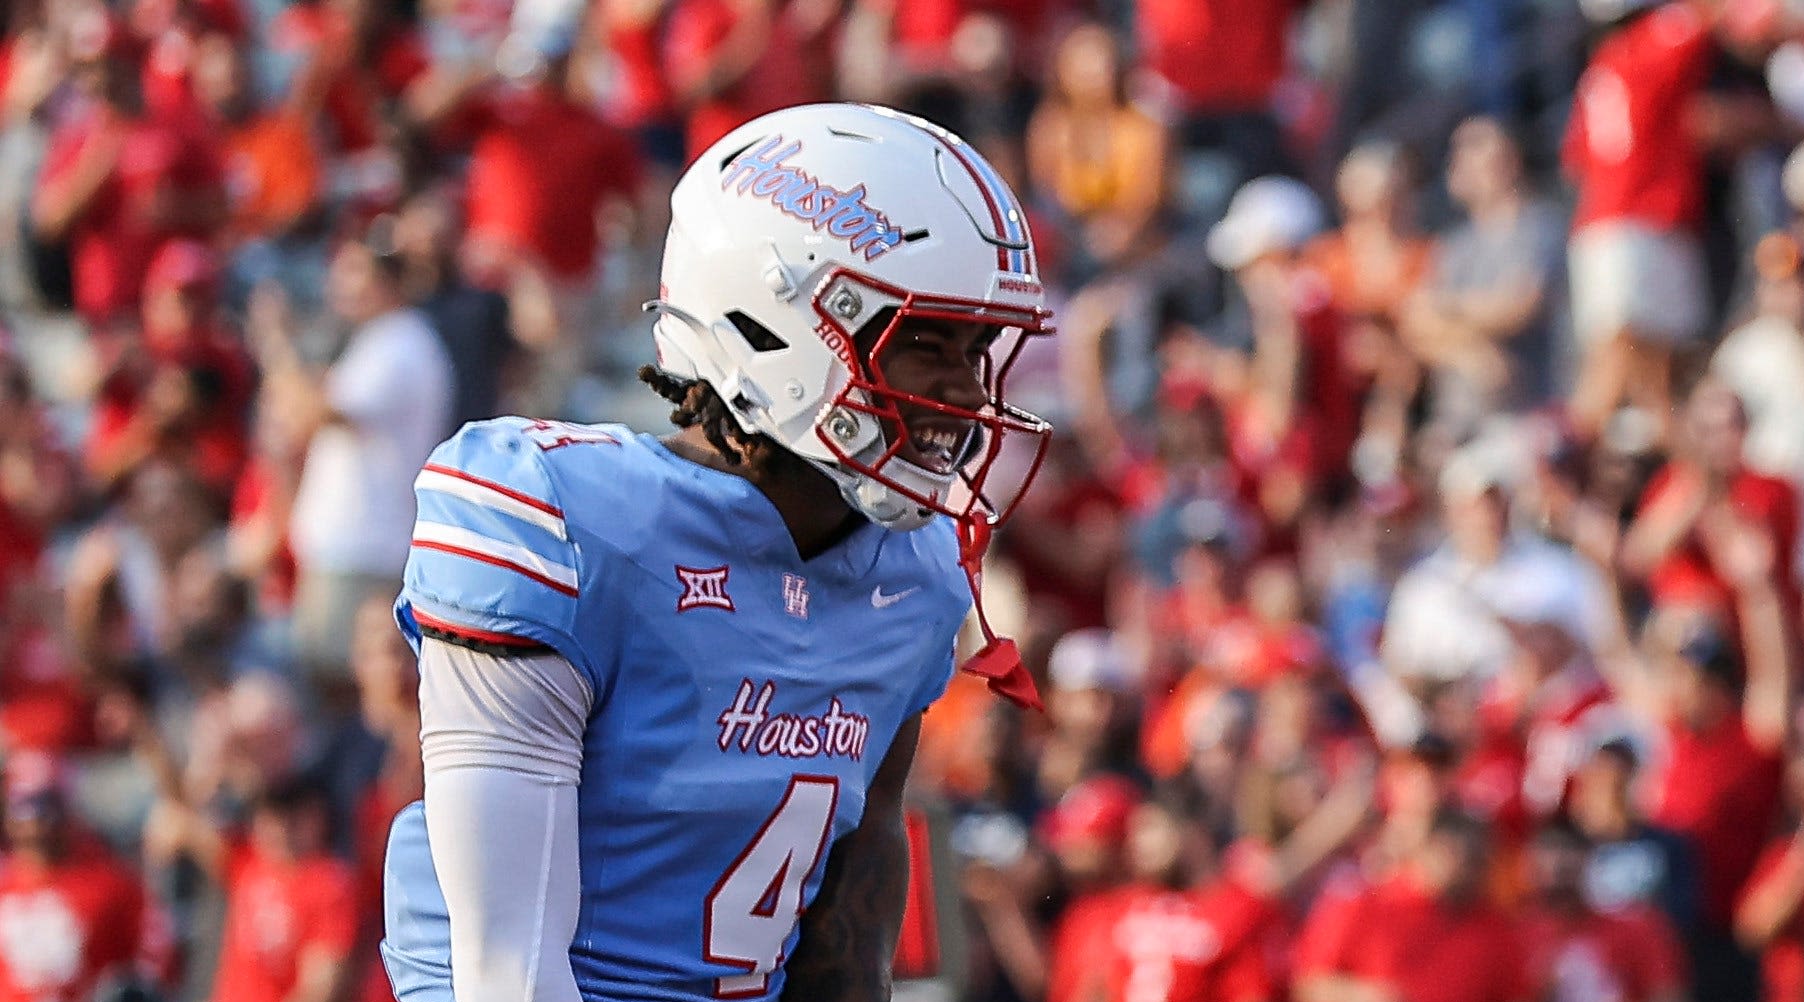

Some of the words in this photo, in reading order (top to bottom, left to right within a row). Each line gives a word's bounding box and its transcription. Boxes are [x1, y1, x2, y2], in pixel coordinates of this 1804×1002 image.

[721, 134, 903, 262] Houston
[717, 677, 870, 762] Houston
[703, 773, 840, 1000] 4
